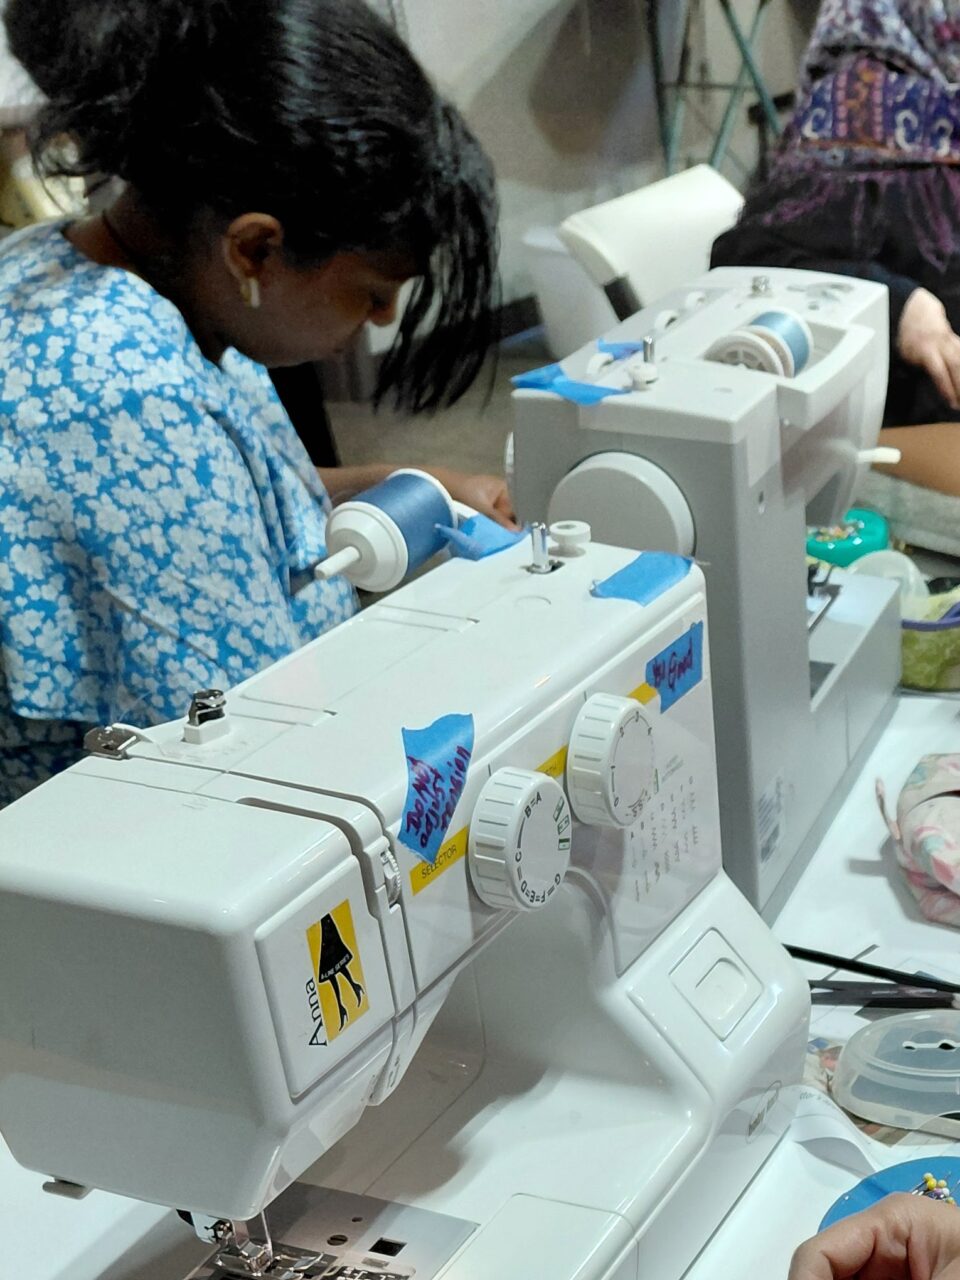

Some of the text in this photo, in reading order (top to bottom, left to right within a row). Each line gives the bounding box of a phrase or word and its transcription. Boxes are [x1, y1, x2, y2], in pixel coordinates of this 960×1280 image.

[420, 843, 458, 880] SELECTOR
[514, 791, 561, 903] A B C D E F G
[305, 976, 328, 1047] Anna
